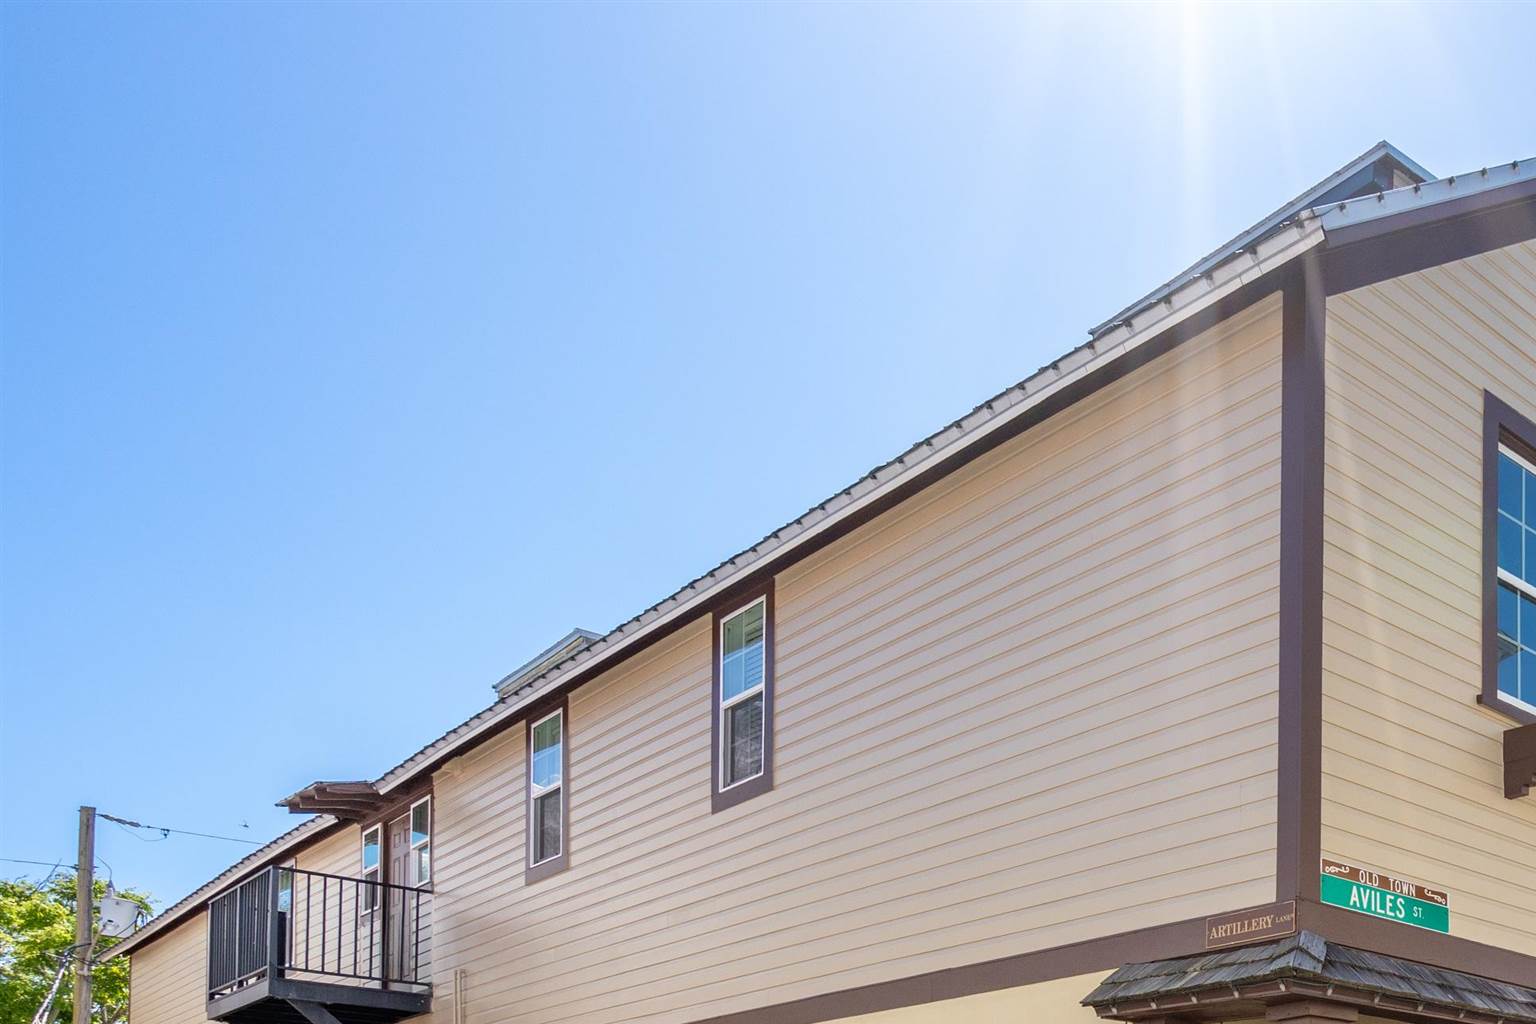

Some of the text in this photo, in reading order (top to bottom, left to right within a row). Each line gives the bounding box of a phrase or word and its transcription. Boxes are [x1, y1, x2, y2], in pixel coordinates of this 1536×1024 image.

[1359, 870, 1416, 897] OLD TOWN
[1349, 885, 1425, 920] AVILES ST.
[1209, 914, 1274, 940] ARTILLERY
